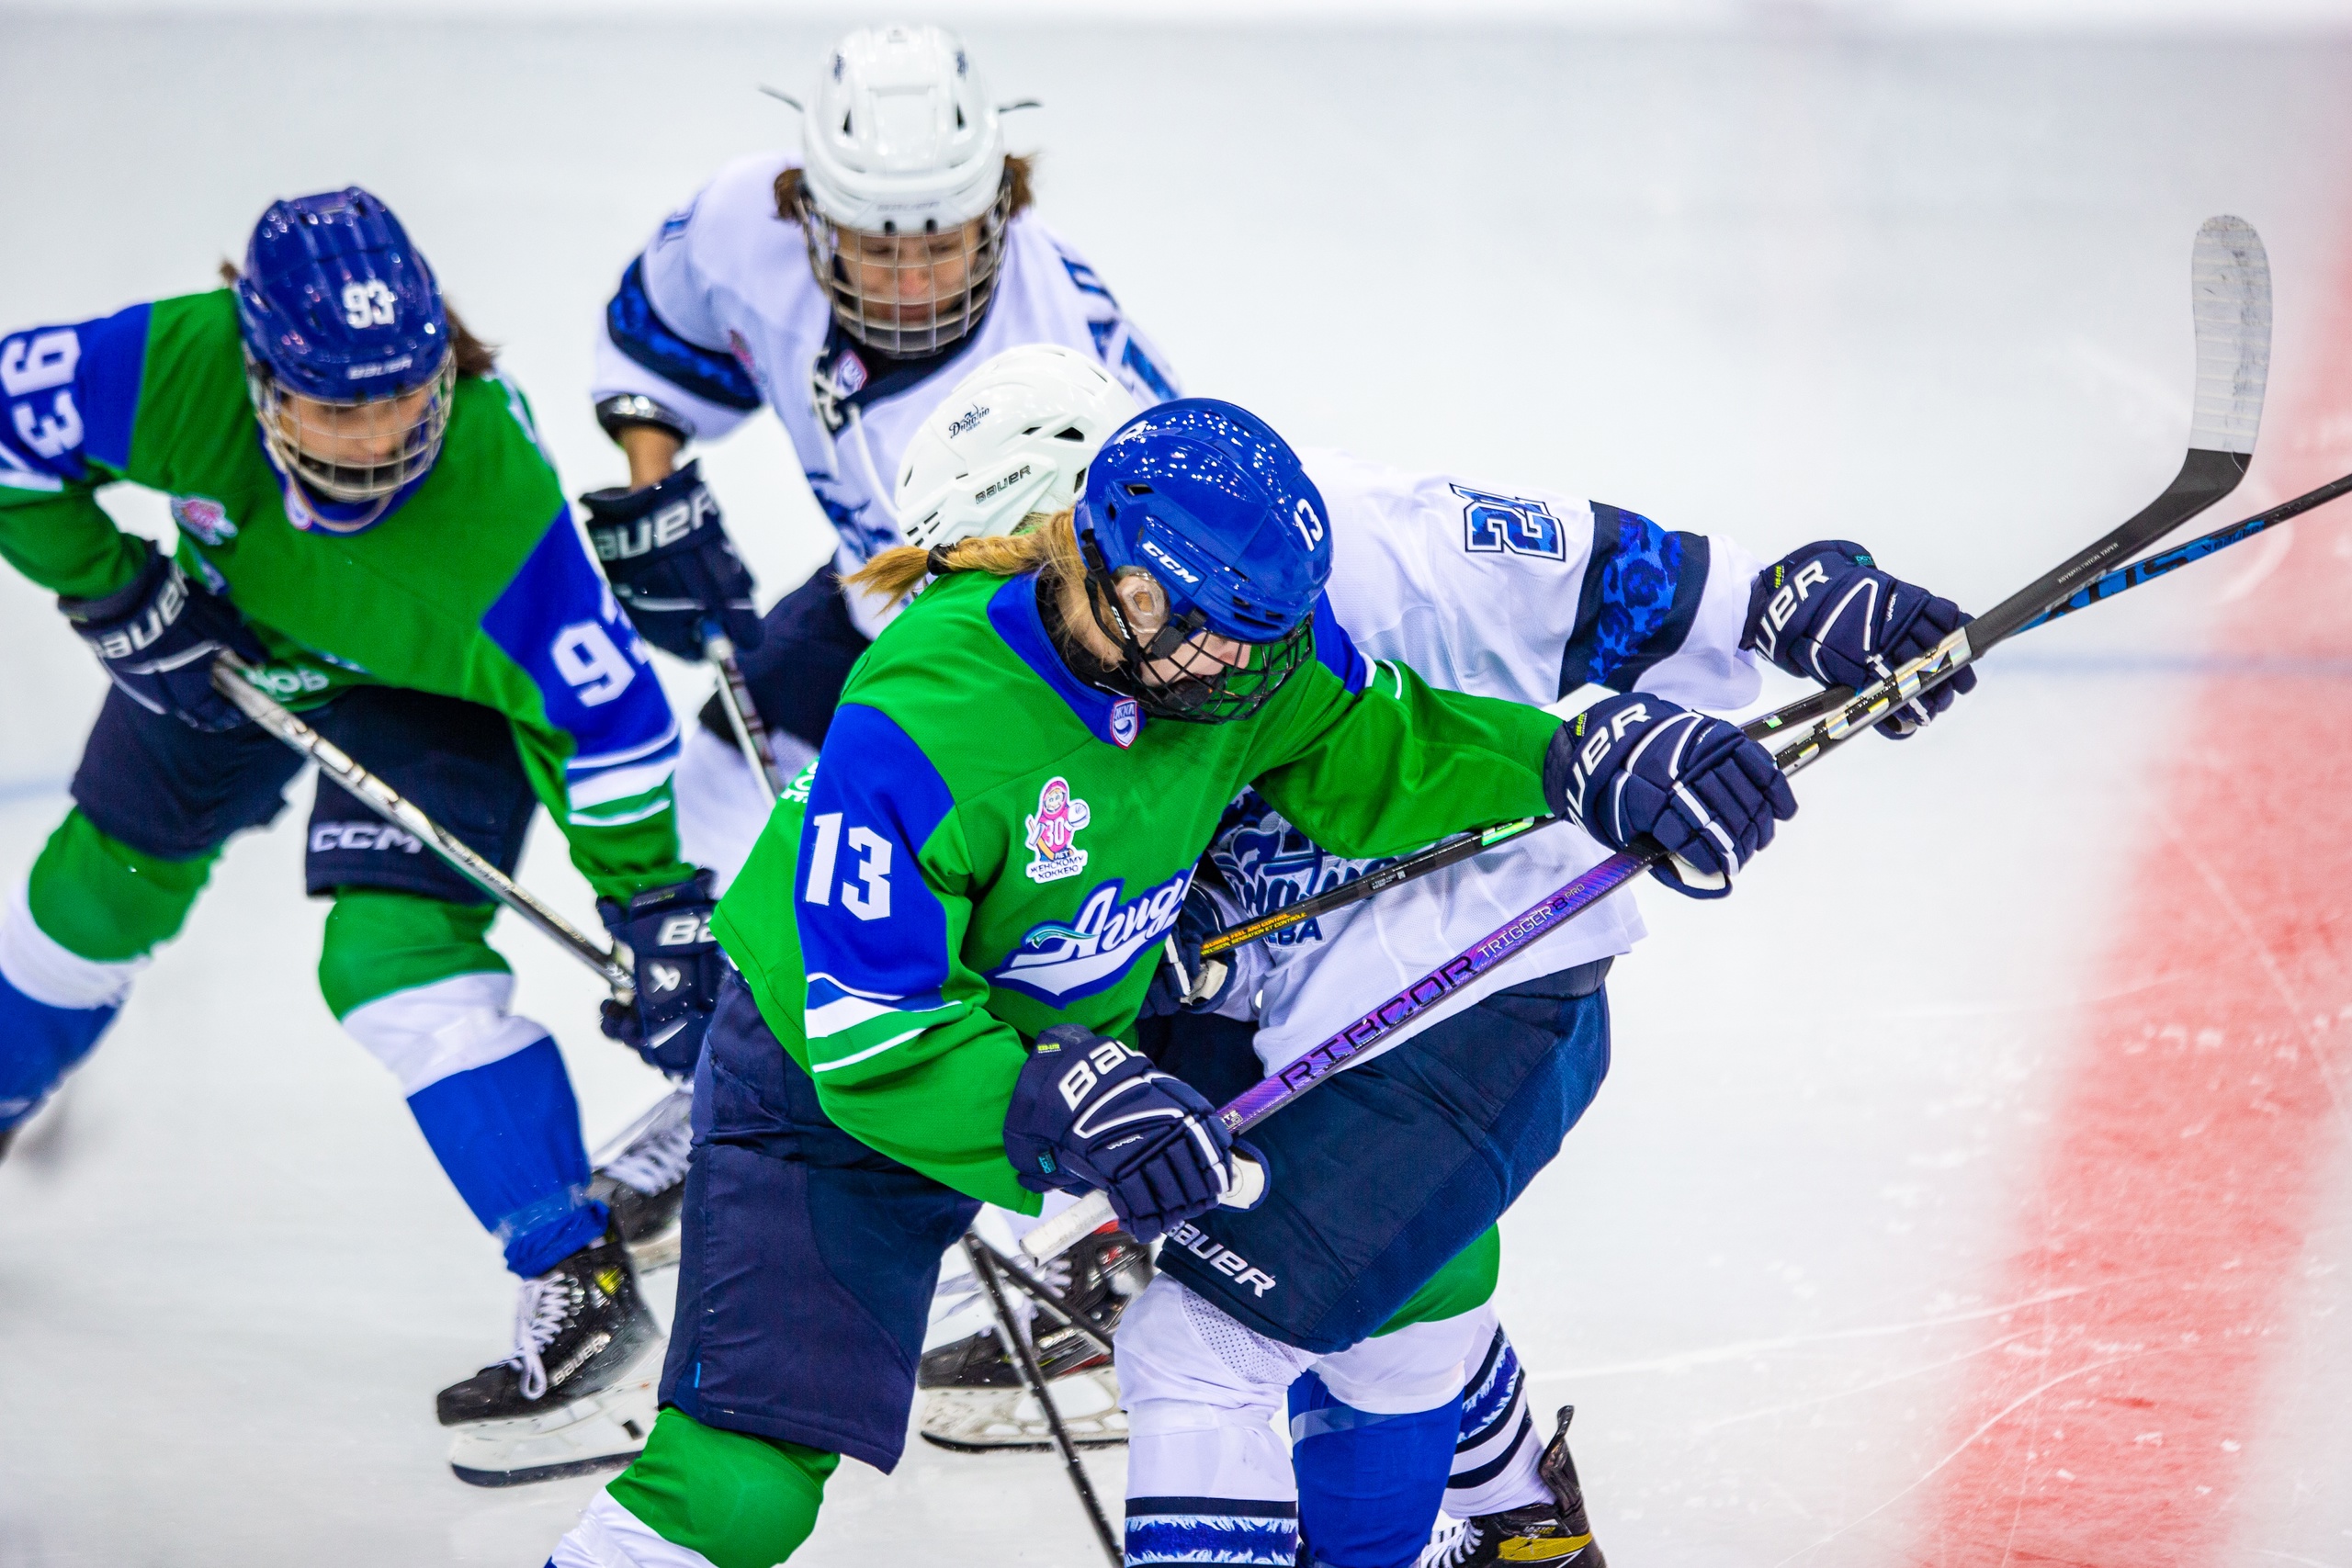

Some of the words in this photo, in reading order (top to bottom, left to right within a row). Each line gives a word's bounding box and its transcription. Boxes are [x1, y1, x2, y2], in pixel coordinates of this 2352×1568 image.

[342, 278, 395, 329] 93
[0, 328, 85, 459] 93
[975, 465, 1032, 505] BAUER
[593, 484, 720, 561] AUER
[1293, 498, 1324, 552] 13
[1449, 482, 1566, 562] 21
[1142, 540, 1200, 584] CCM
[1111, 605, 1131, 639] CCM
[1755, 559, 1830, 663] UER
[1566, 703, 1651, 834] UER
[310, 822, 424, 854] CCM
[1046, 817, 1065, 848] 30
[805, 811, 893, 921] 13
[1030, 855, 1084, 874] ЖЕНСКОМУ
[1038, 865, 1080, 880] ХОККЕЮ
[1247, 923, 1261, 933] AND
[1279, 955, 1478, 1093] RIBCOR
[1477, 905, 1555, 958] TRIGGER
[1552, 897, 1568, 911] 8
[1565, 884, 1586, 899] PRO
